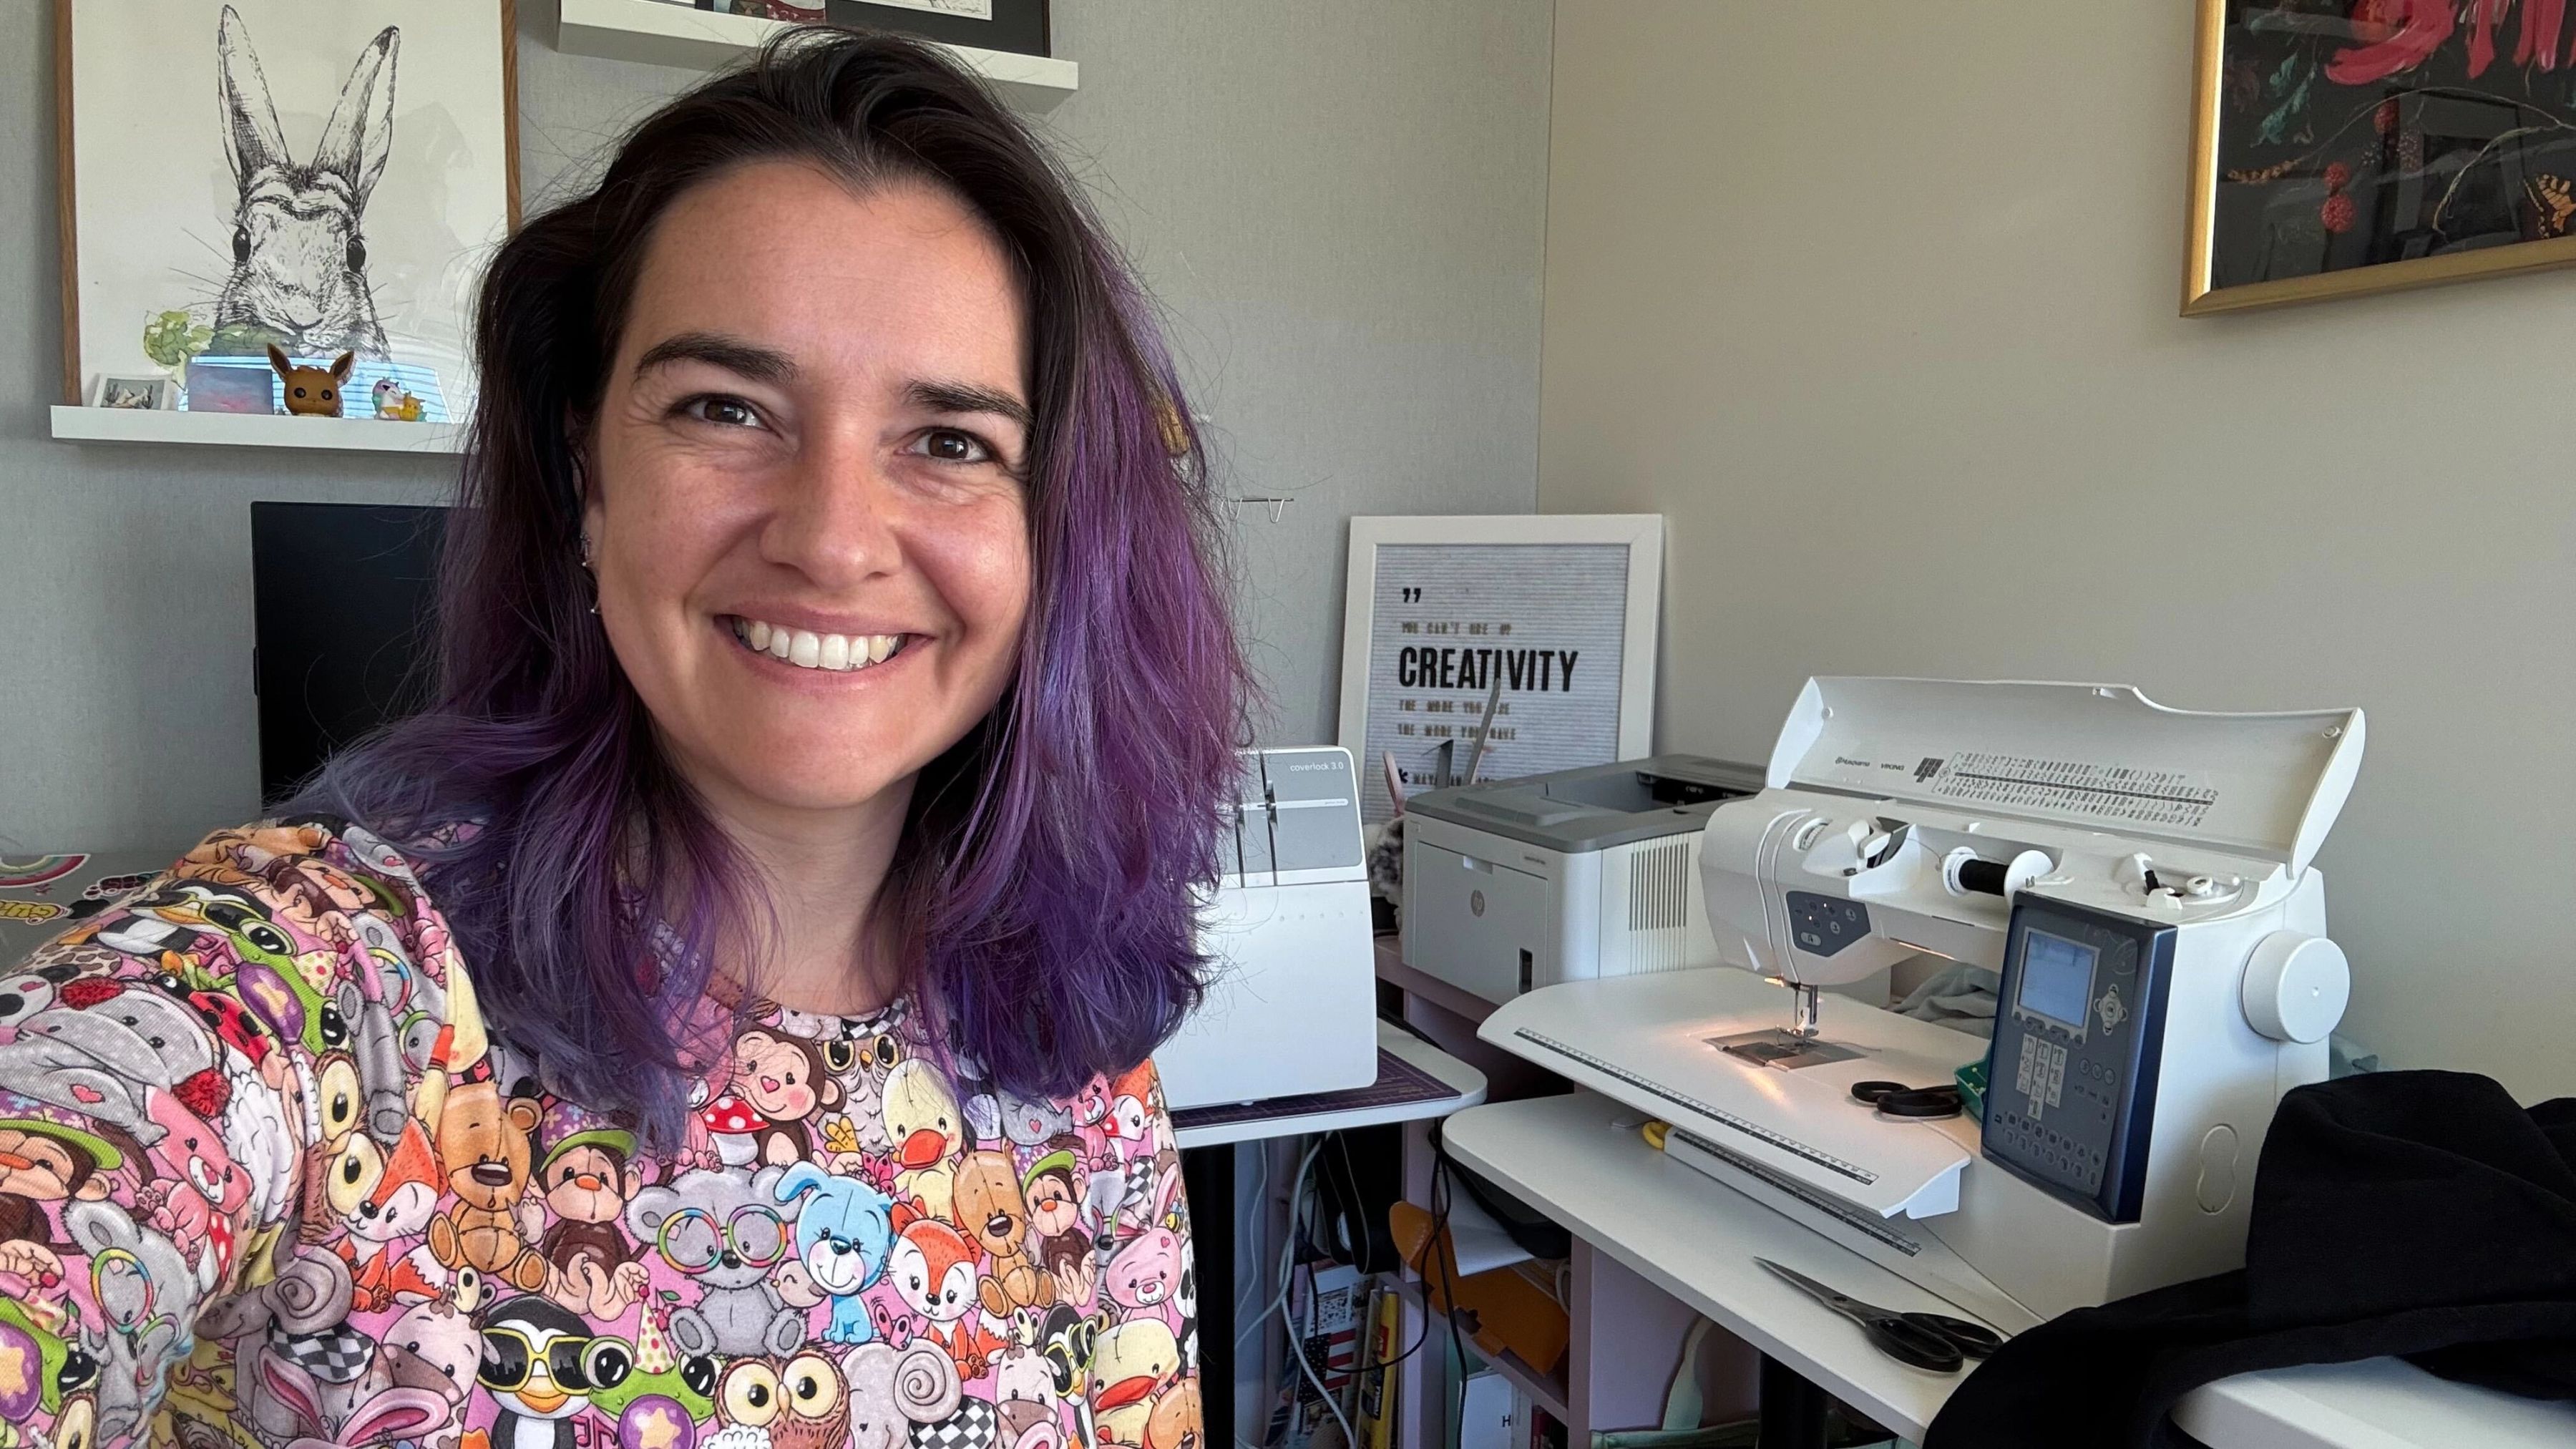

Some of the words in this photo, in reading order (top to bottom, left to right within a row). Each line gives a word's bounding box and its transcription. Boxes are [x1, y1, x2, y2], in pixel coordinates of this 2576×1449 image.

[1399, 647, 1579, 692] CREATIVITY
[1289, 762, 1330, 772] coverlock
[1331, 761, 1345, 771] 3.0
